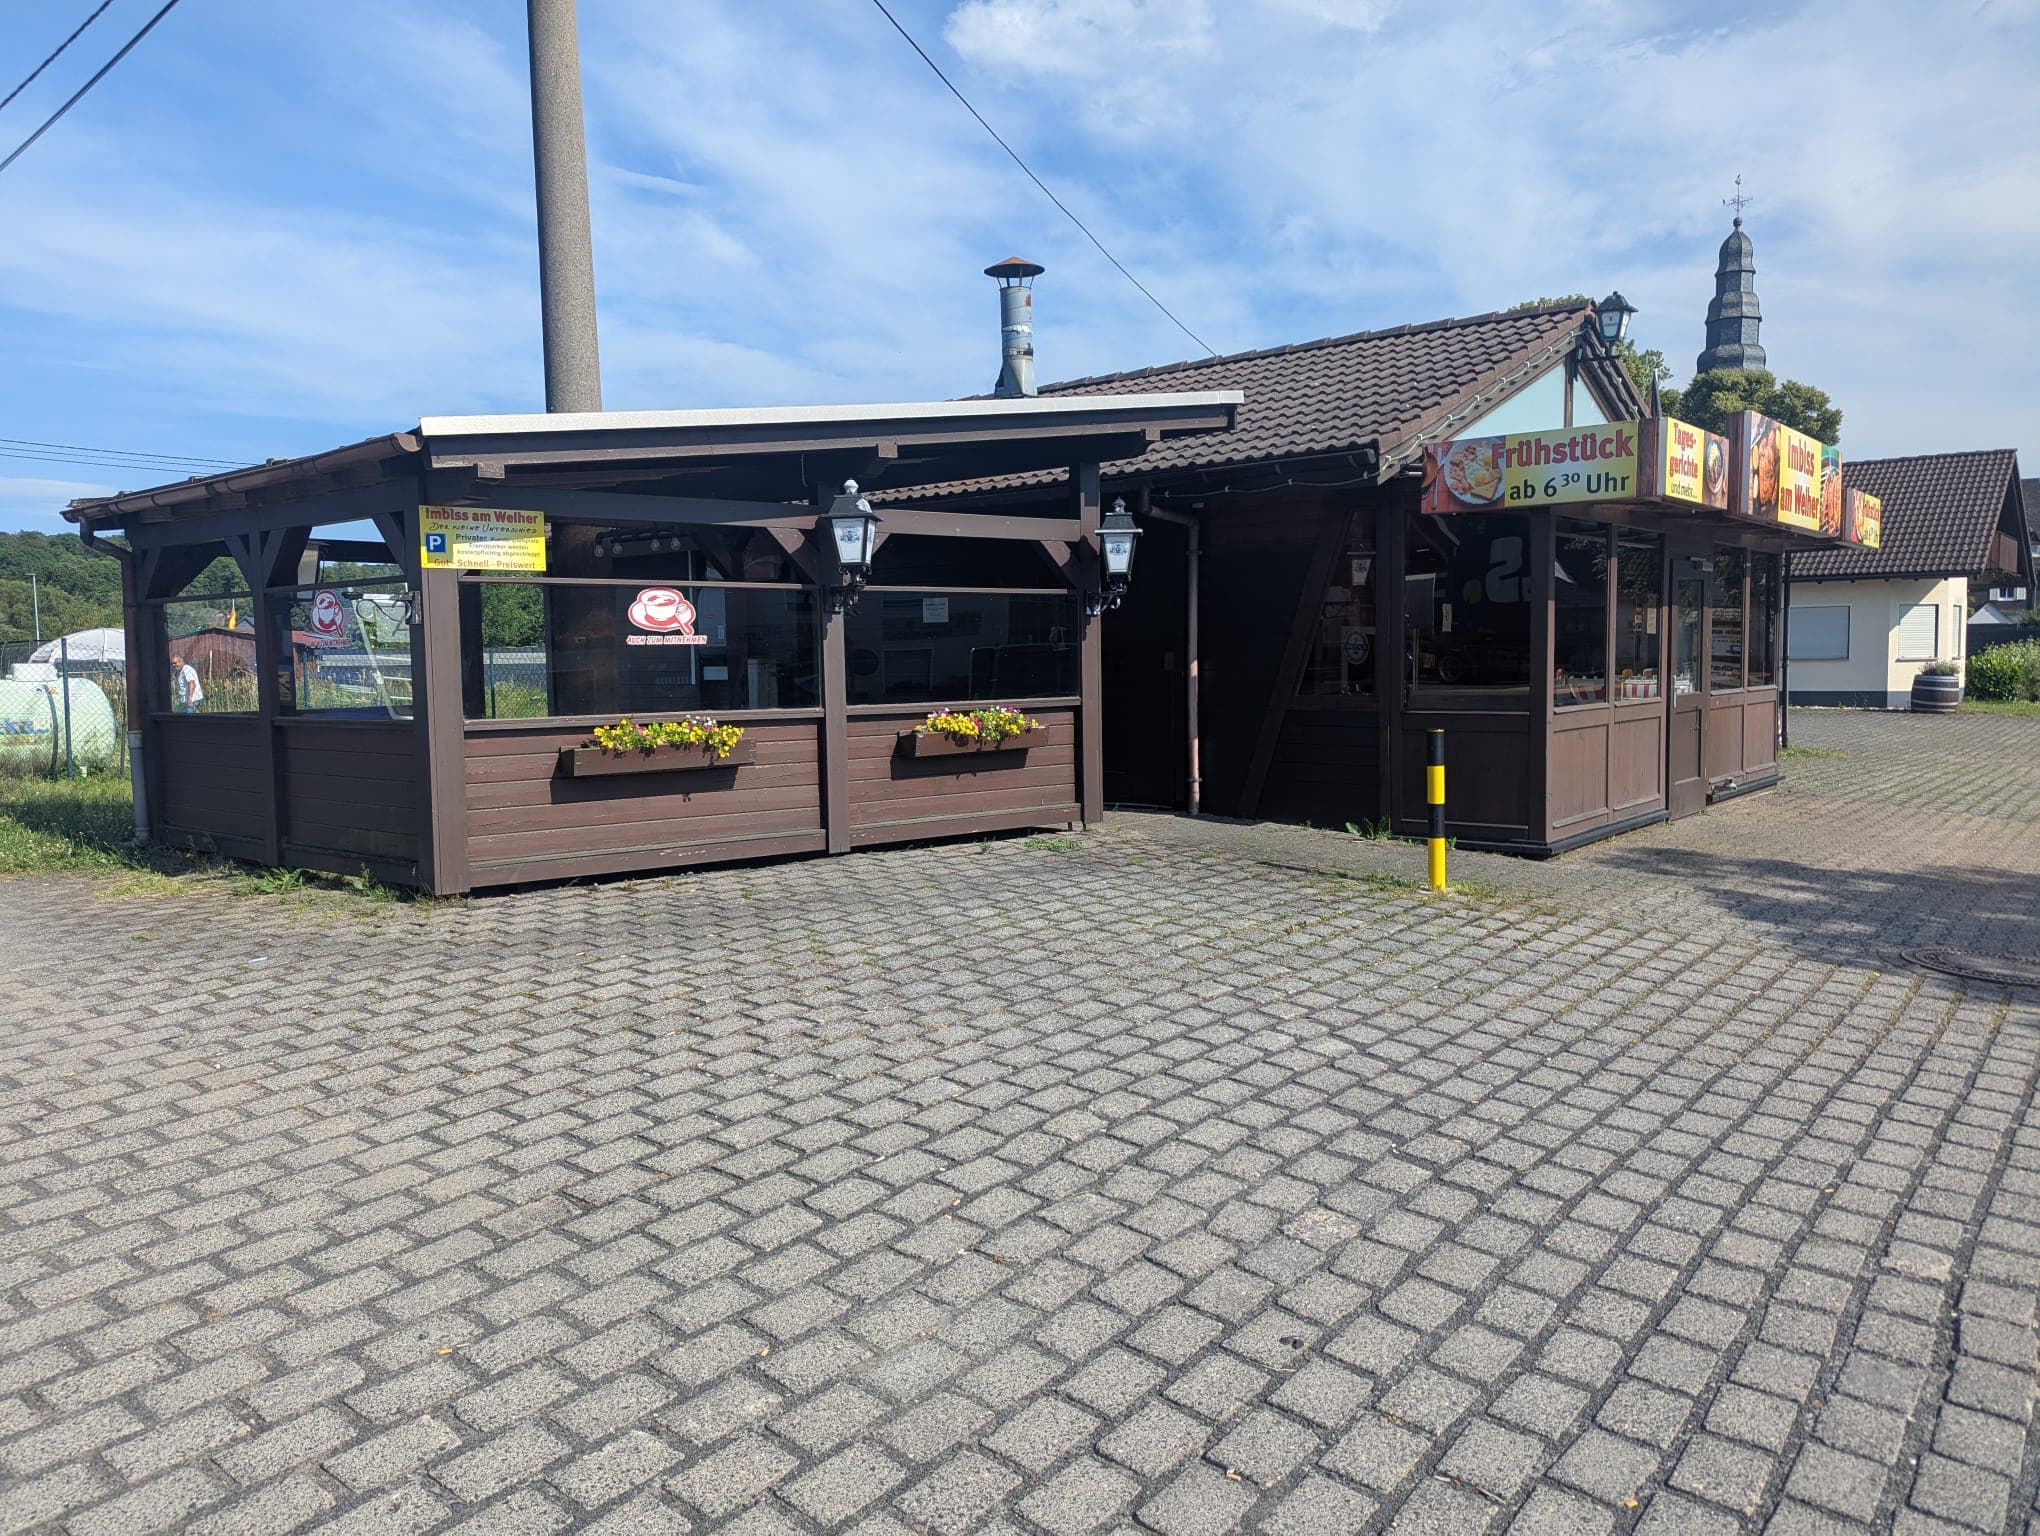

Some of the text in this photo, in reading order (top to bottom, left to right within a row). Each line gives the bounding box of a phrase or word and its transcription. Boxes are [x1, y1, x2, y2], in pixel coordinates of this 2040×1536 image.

[1491, 429, 1635, 470] Frühstück
[1673, 422, 1697, 451] Tages-
[1669, 452, 1699, 479] gerichte
[1787, 434, 1815, 478] Imbiss
[1509, 479, 1536, 501] ab
[1586, 471, 1631, 494] Uhr
[1780, 482, 1820, 520] am Weiher
[425, 507, 539, 525] Imbiss am Weiher
[429, 535, 442, 551] P
[455, 533, 487, 543] Privater
[434, 558, 450, 567] Gut
[457, 559, 490, 568] Schnell
[496, 560, 537, 569] Preiswert
